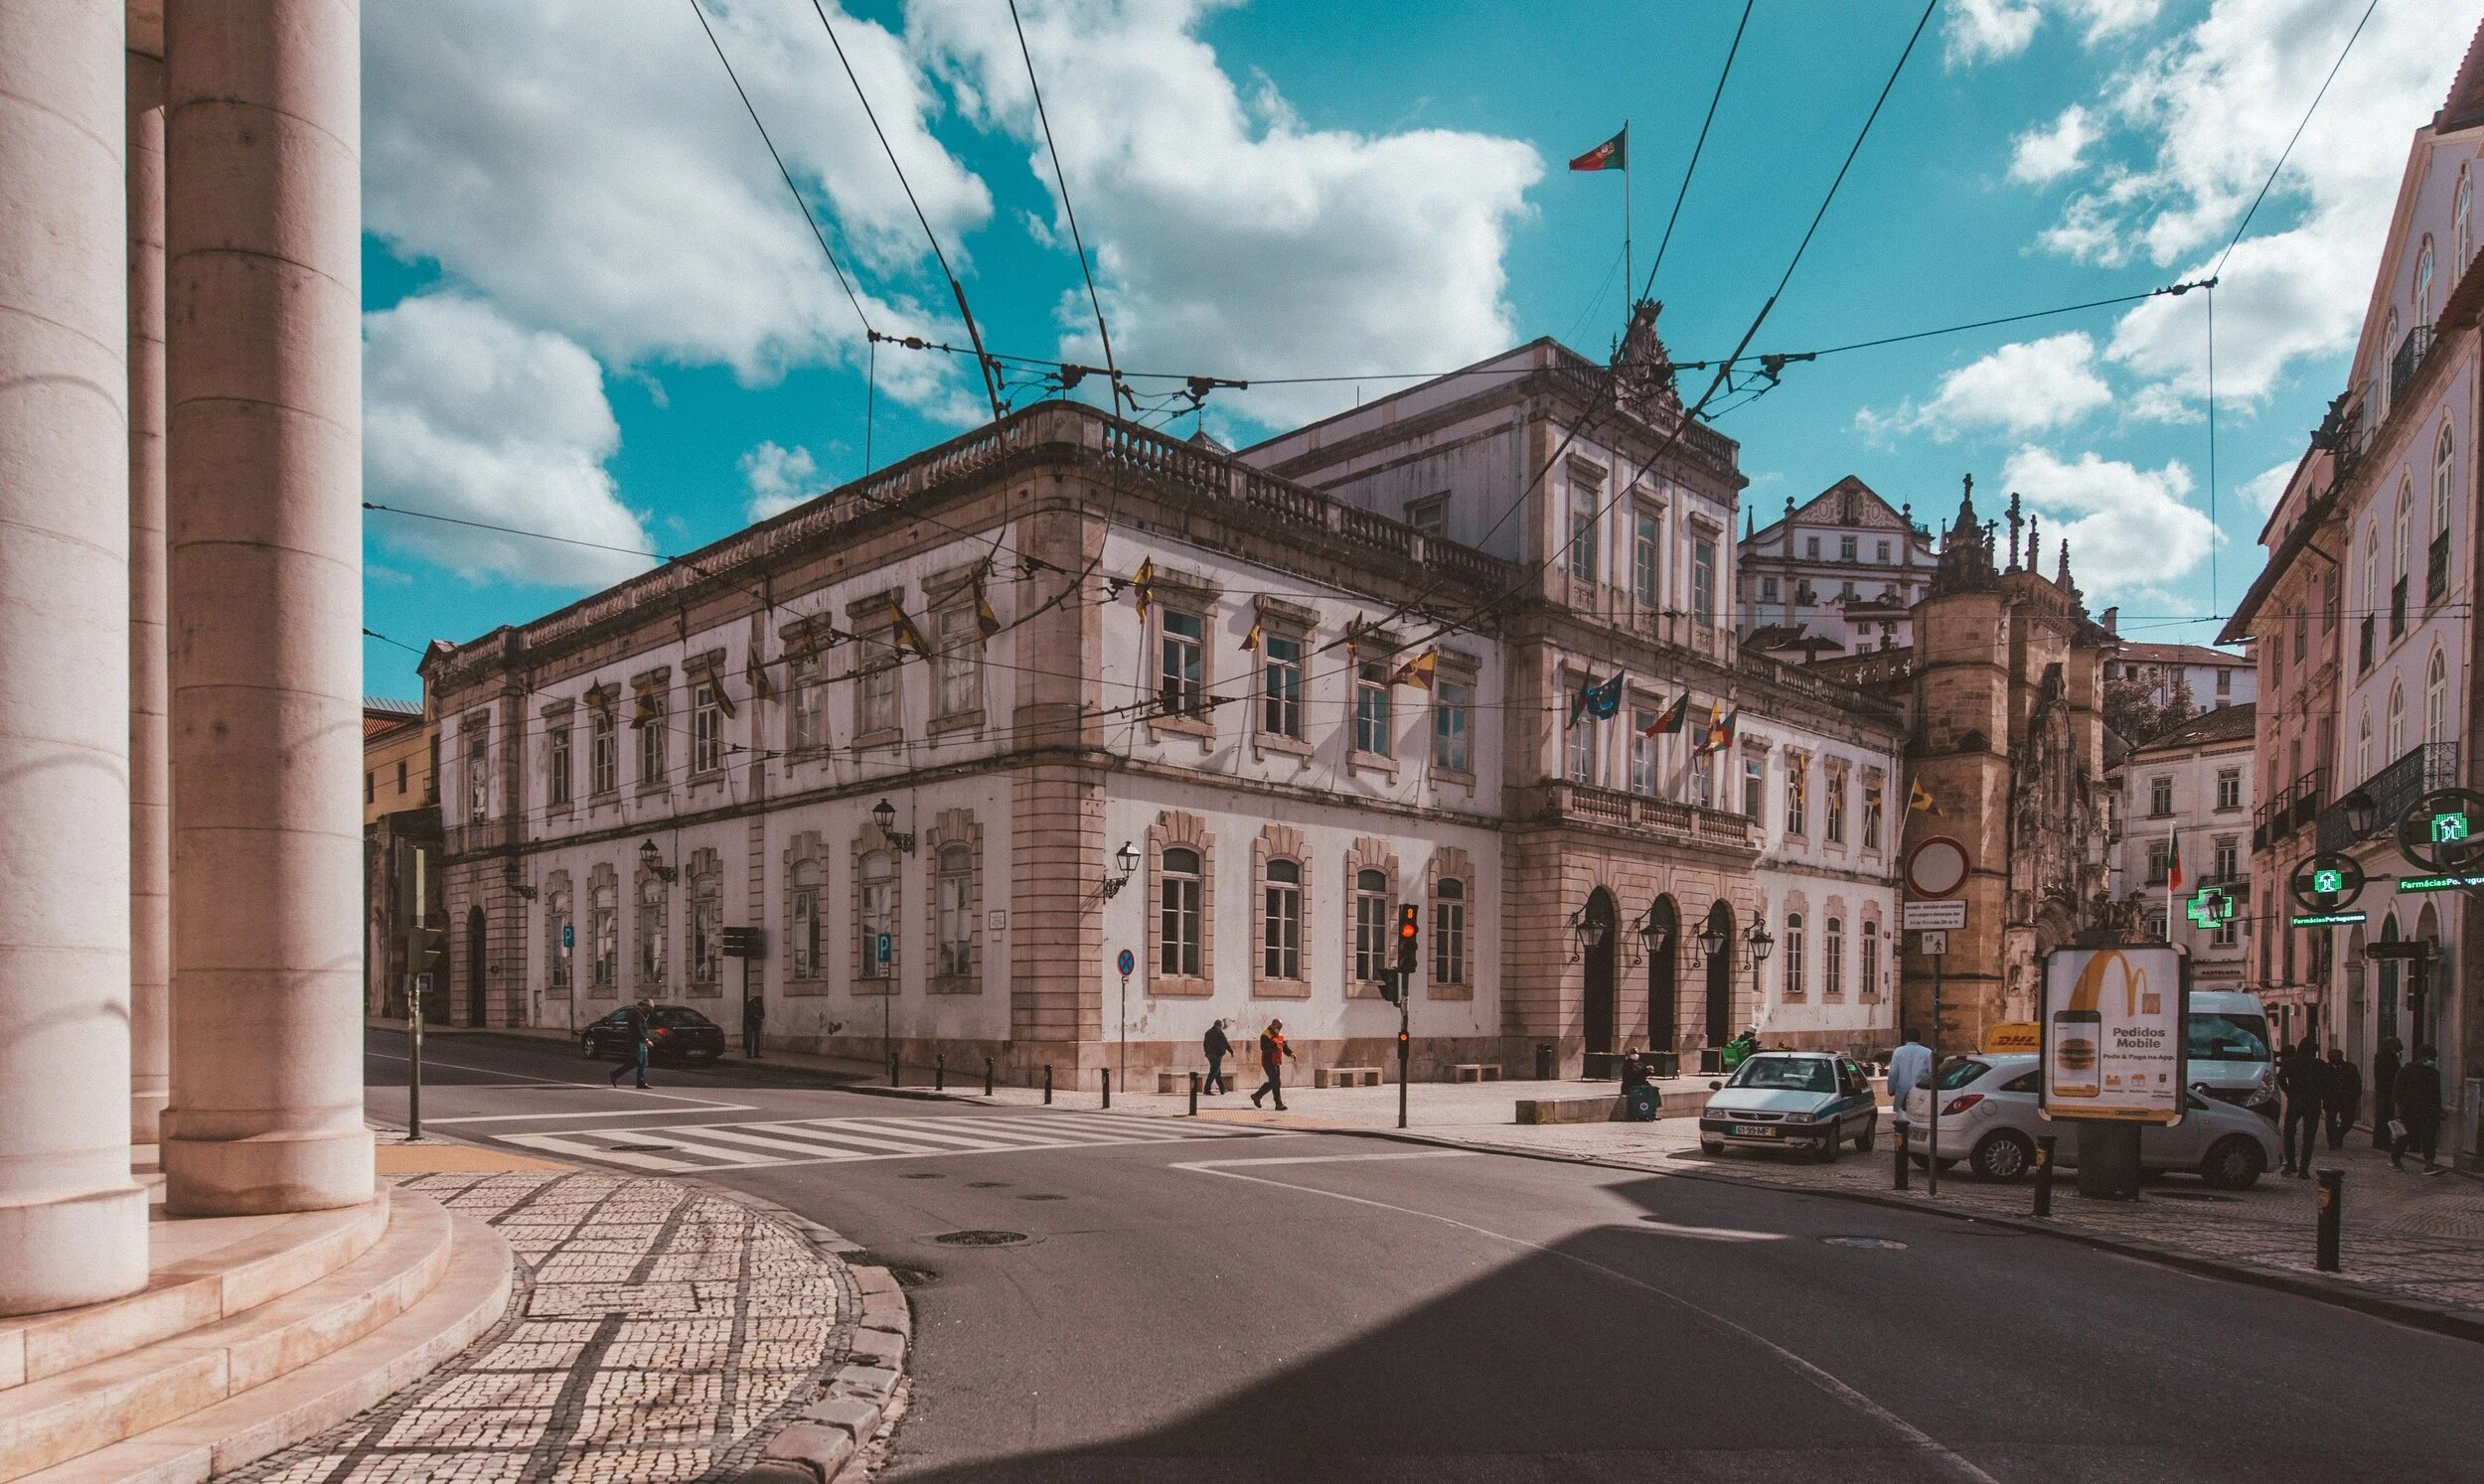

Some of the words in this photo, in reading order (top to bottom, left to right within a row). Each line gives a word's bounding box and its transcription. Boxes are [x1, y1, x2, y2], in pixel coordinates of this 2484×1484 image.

[565, 928, 572, 947] P
[880, 936, 888, 959] P
[2112, 1027, 2166, 1037] Pedidos
[1997, 1036, 2036, 1046] DHL
[2116, 1038, 2161, 1048] Mobile
